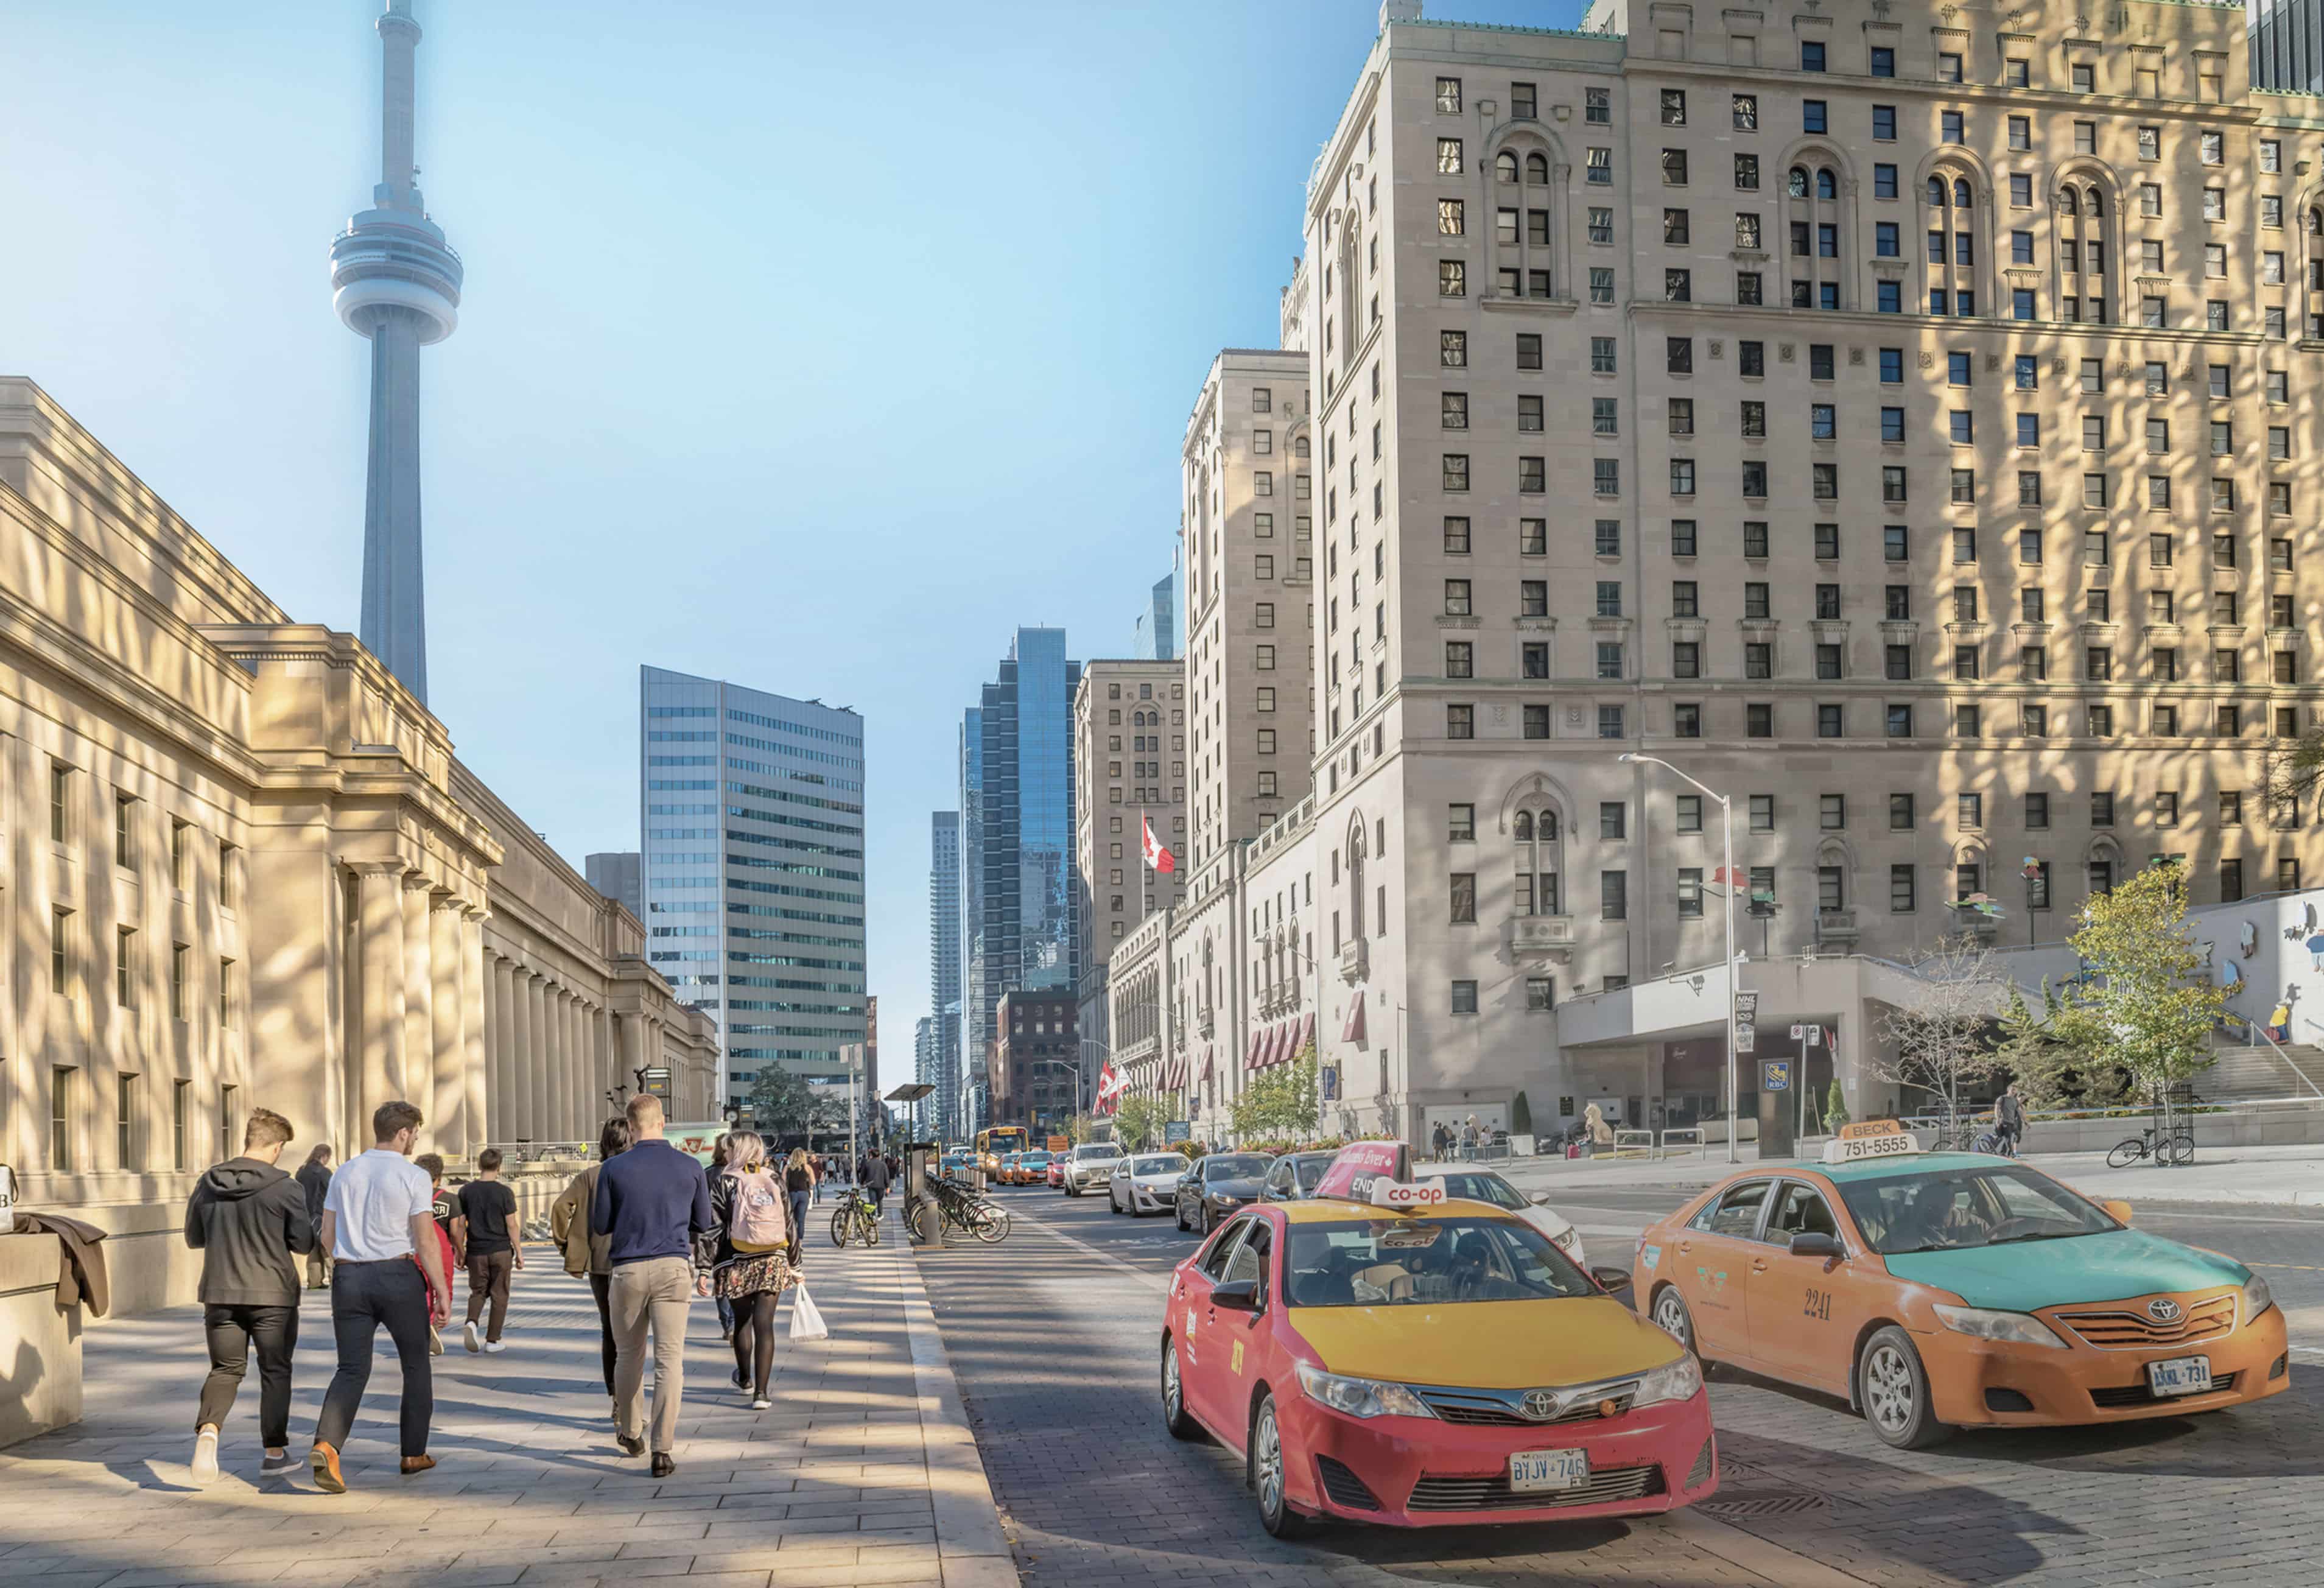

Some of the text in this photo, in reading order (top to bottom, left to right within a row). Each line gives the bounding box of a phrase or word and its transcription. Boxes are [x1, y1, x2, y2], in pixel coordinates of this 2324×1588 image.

[1853, 1123, 1892, 1136] BECK
[1844, 1136, 1908, 1157] 751-5555
[1363, 1149, 1385, 1167] Ever
[1803, 1287, 1831, 1321] 2241
